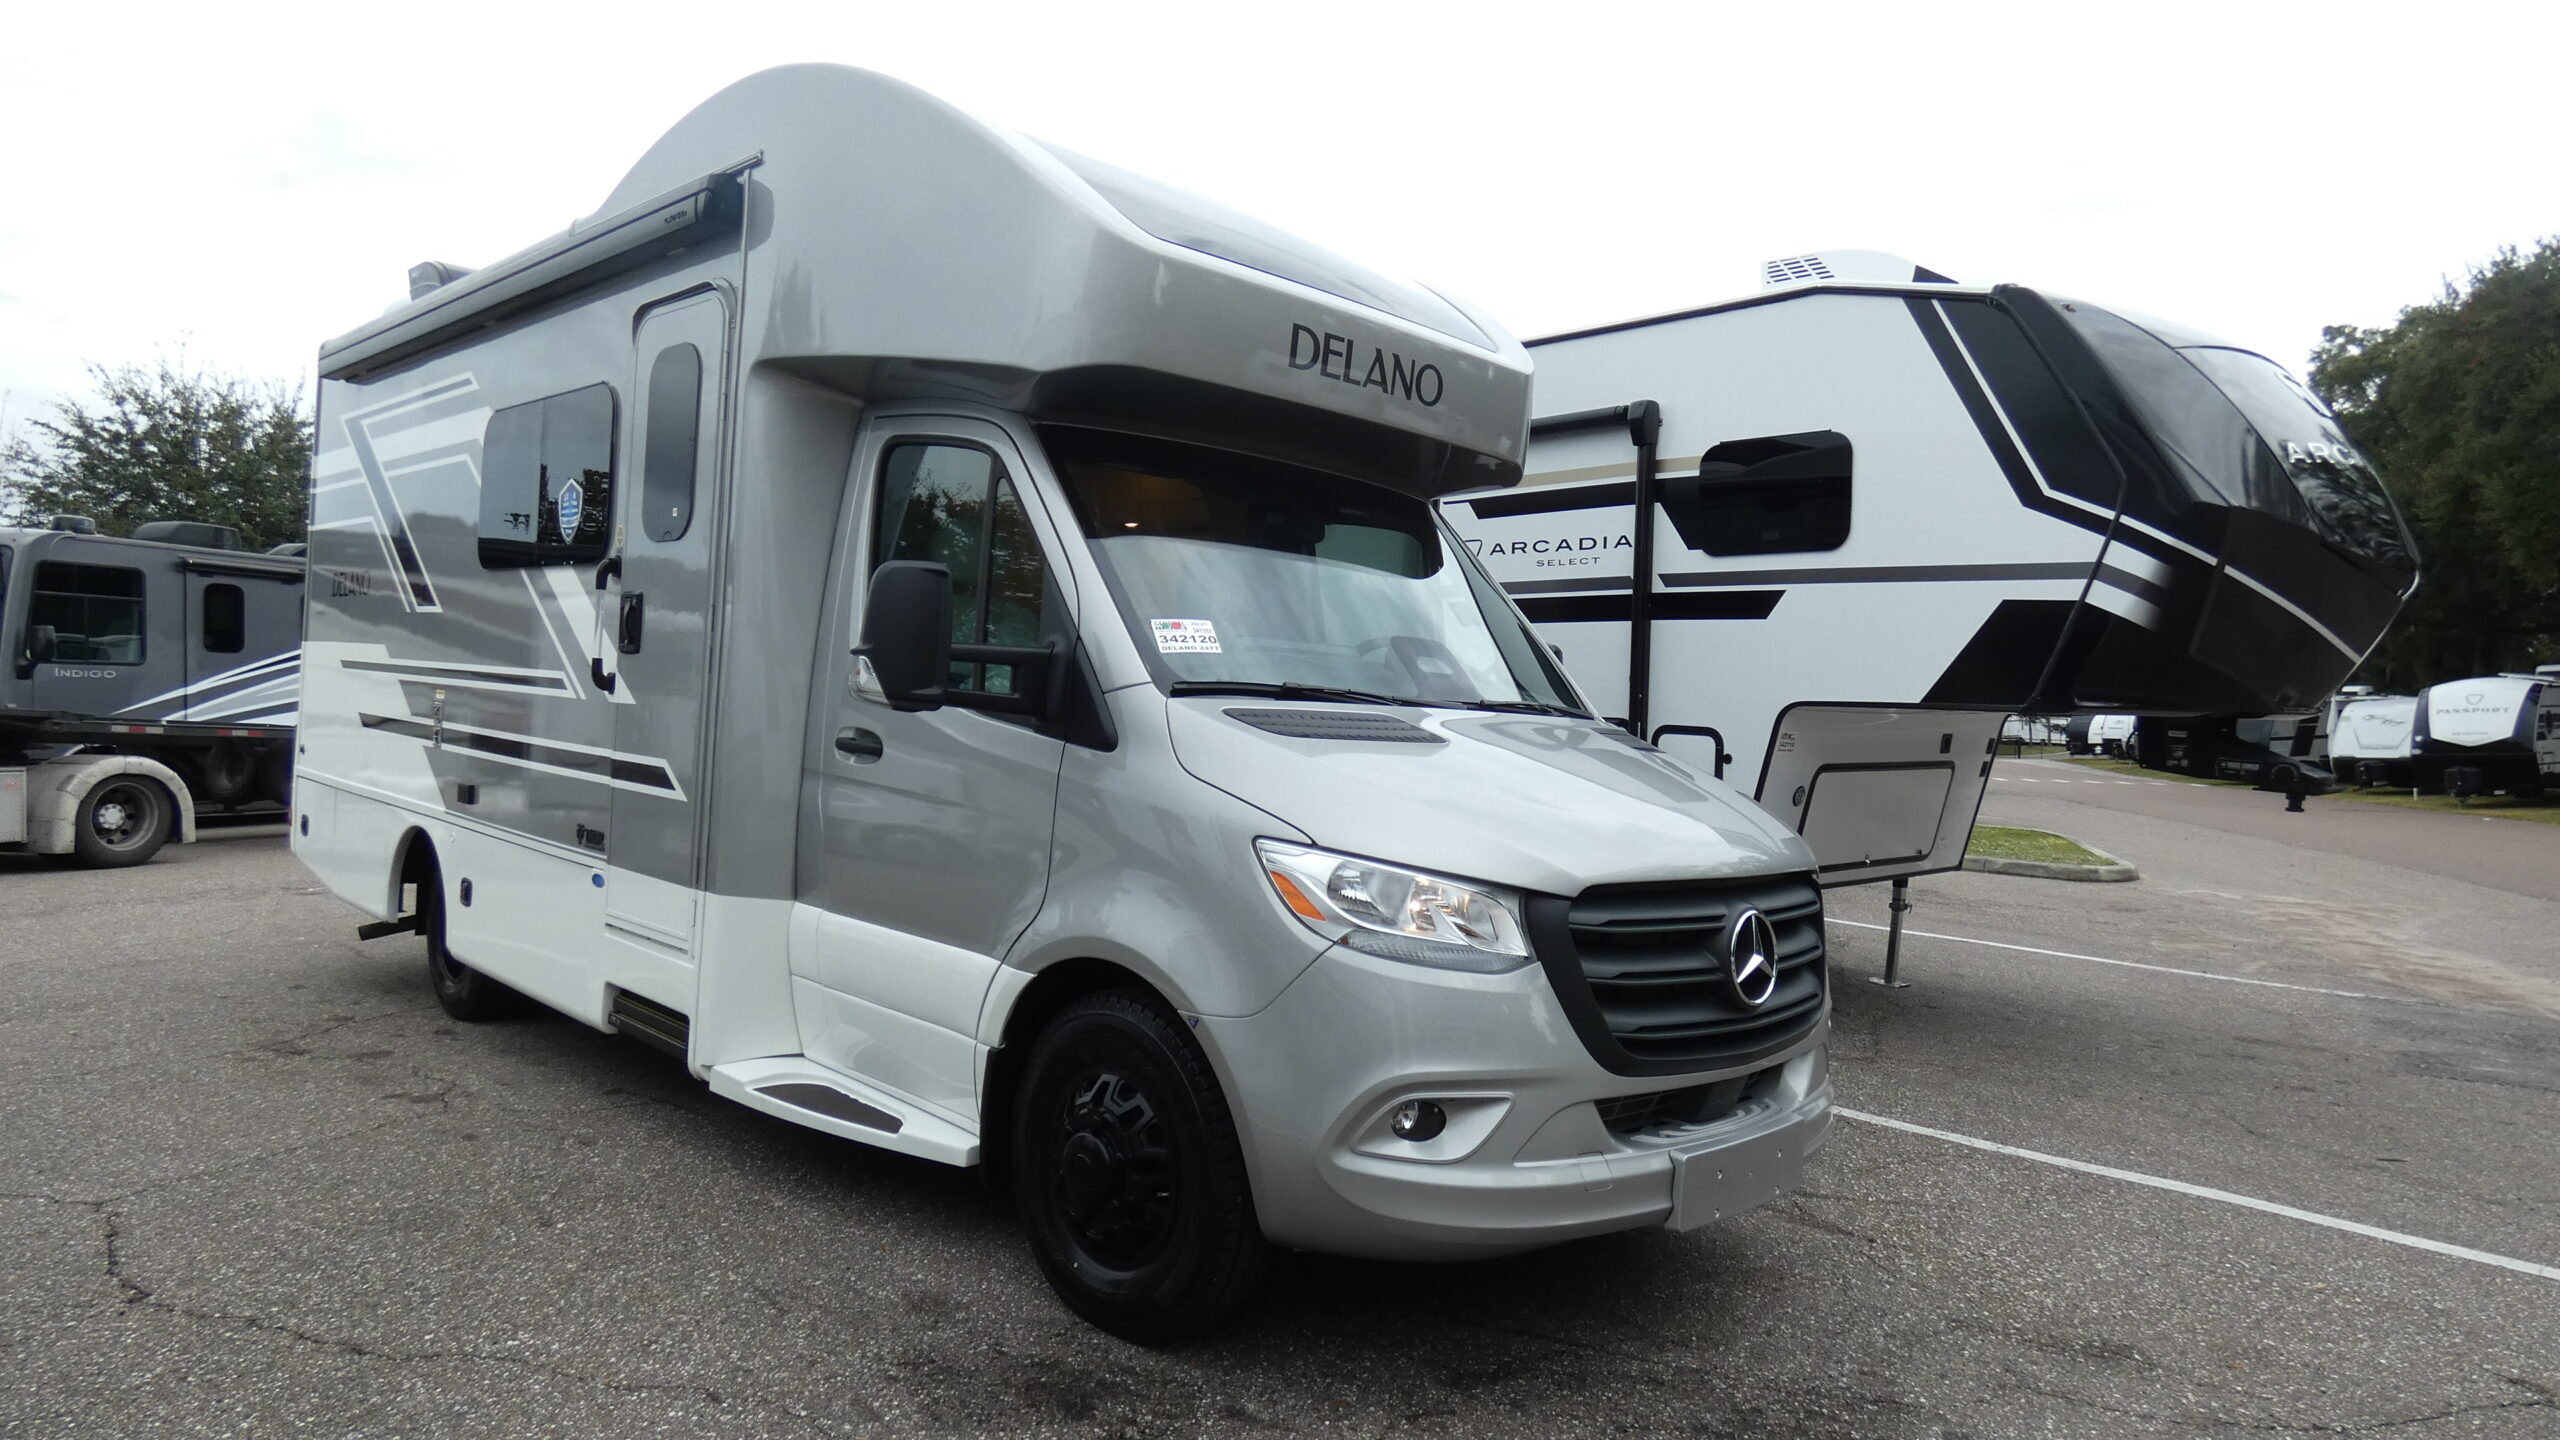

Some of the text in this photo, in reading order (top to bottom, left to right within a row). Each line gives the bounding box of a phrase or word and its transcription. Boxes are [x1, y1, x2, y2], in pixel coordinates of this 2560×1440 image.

[1288, 322, 1443, 407] DELANO
[1489, 534, 1633, 556] ARCADIA
[1536, 556, 1601, 567] SELECT
[331, 570, 371, 598] DELANO
[1159, 634, 1218, 644] 342120
[55, 667, 117, 679] INDIGO
[2436, 706, 2510, 715] PASSPORT
